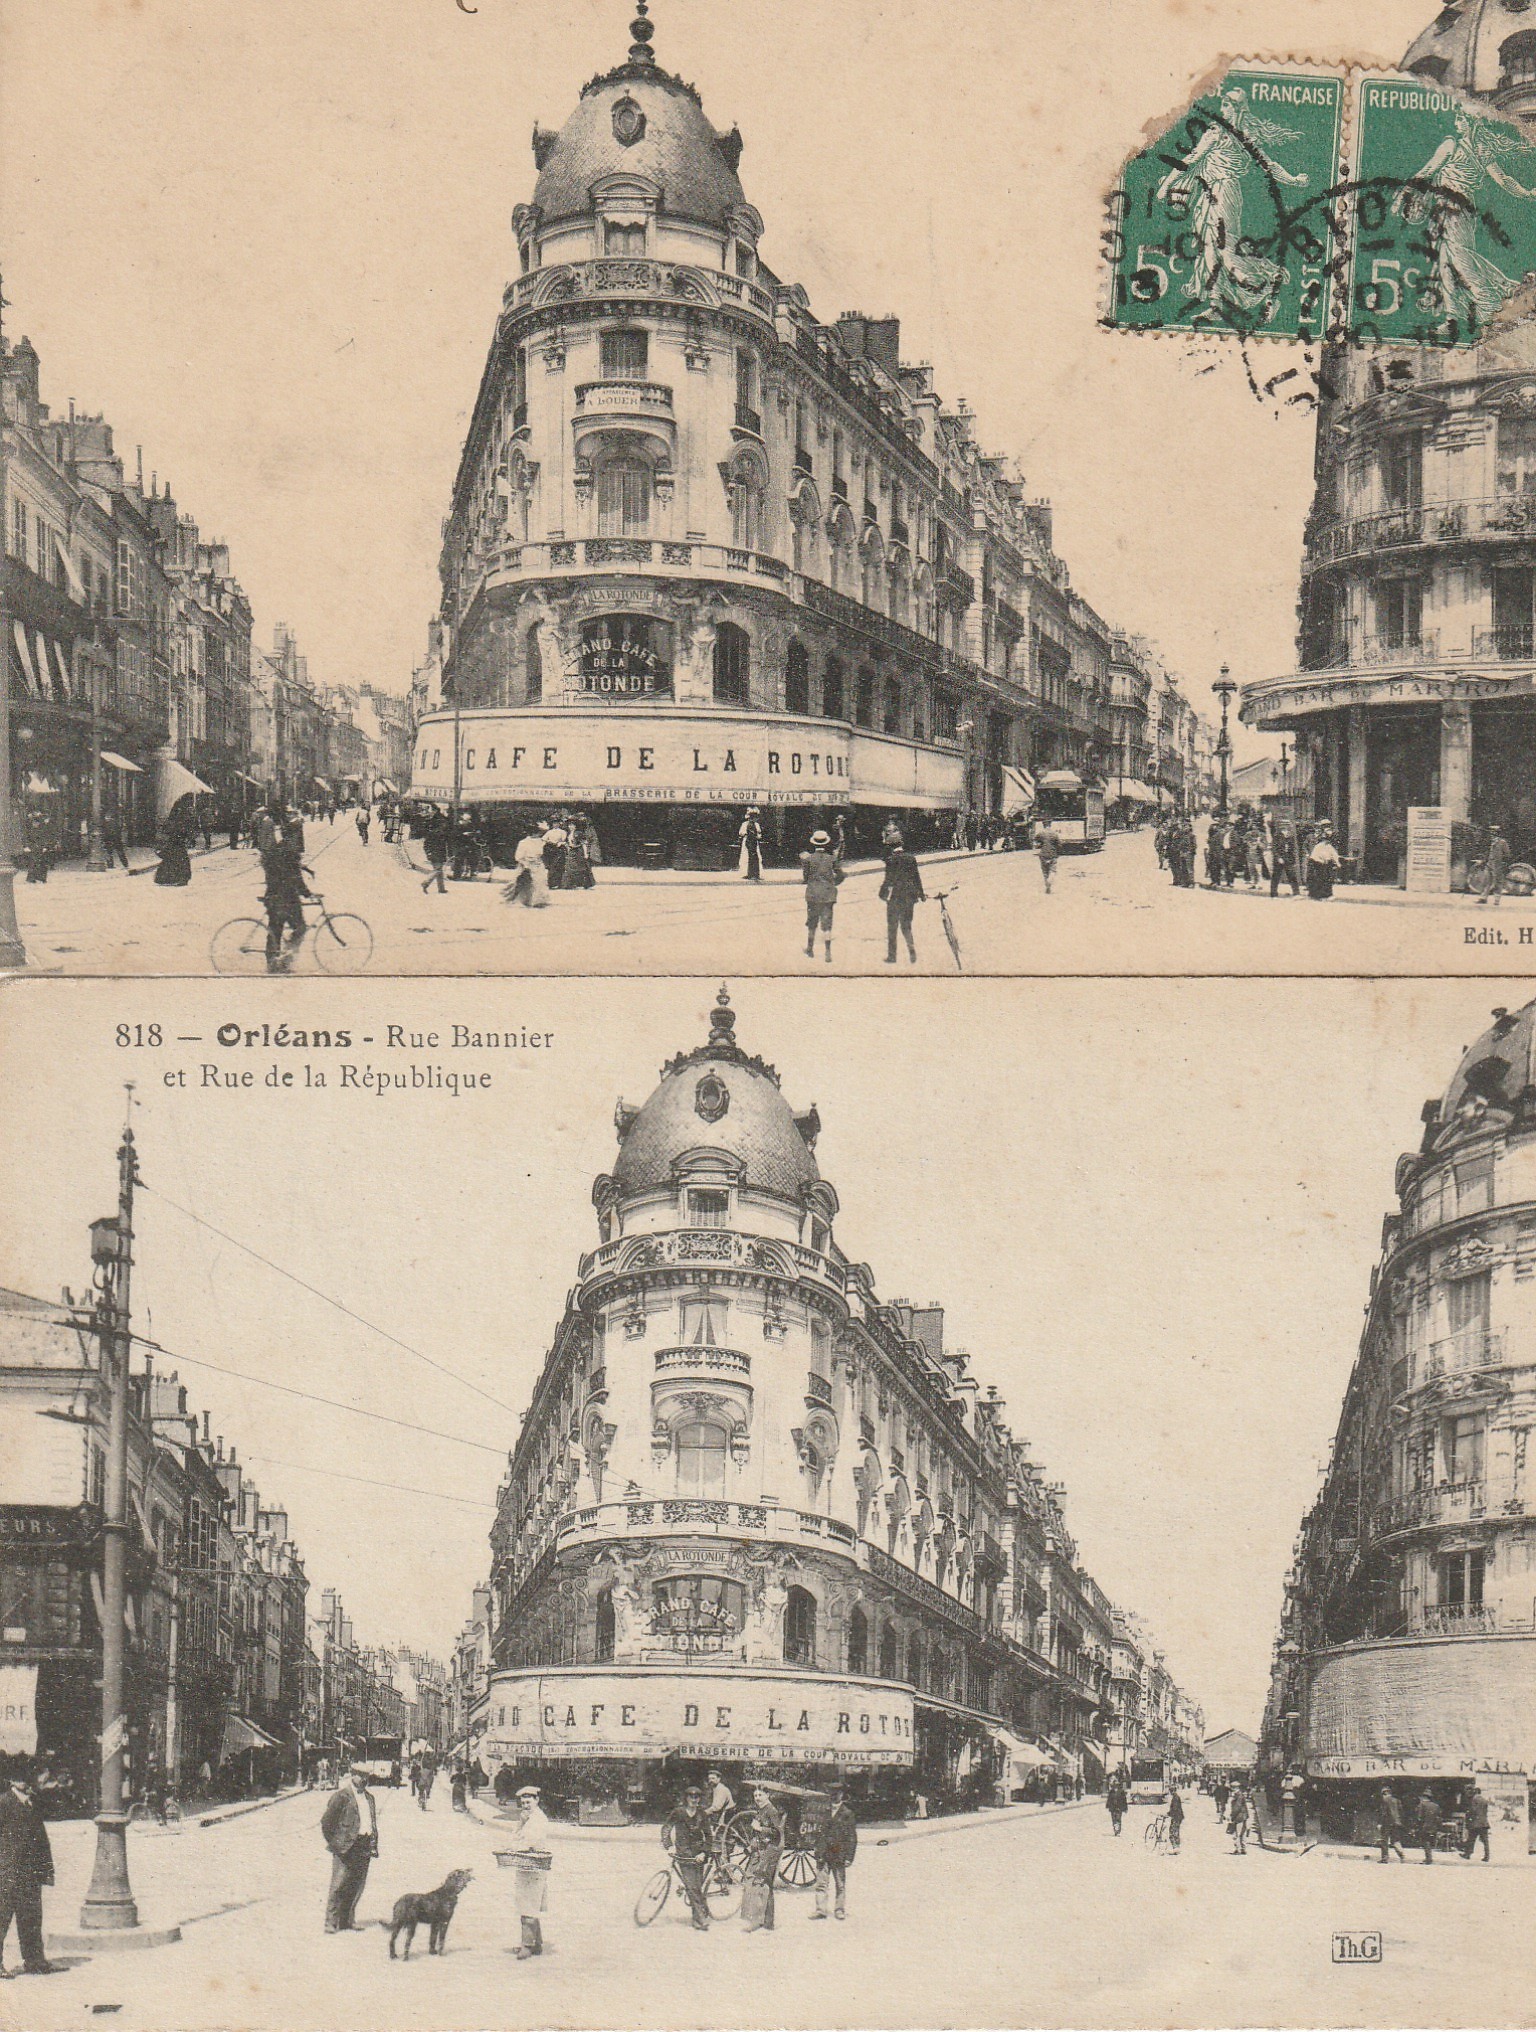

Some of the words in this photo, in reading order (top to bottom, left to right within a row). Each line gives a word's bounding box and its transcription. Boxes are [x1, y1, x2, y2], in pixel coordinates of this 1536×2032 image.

[1252, 83, 1333, 108] FRANÇAISE
[592, 590, 606, 600] LA
[608, 590, 652, 600] ROTONDE
[593, 658, 607, 667] DE
[611, 658, 625, 667] LA
[1294, 690, 1333, 706] BAR
[466, 747, 557, 770] CAFE
[607, 746, 654, 770] DE
[694, 748, 737, 772] LA
[606, 789, 676, 799] BRASSERIE
[686, 790, 700, 799] DE
[709, 791, 723, 799] LA
[732, 792, 758, 800] COUR
[667, 1550, 679, 1560] LA
[680, 1550, 726, 1561] ROTONDE
[544, 1704, 636, 1727] CAFE
[683, 1704, 731, 1728] DE
[767, 1708, 810, 1731] LA
[681, 1745, 749, 1757] BRASSERIE
[758, 1748, 771, 1758] DE
[782, 1749, 794, 1758] LA
[834, 1752, 872, 1761] ROYALE
